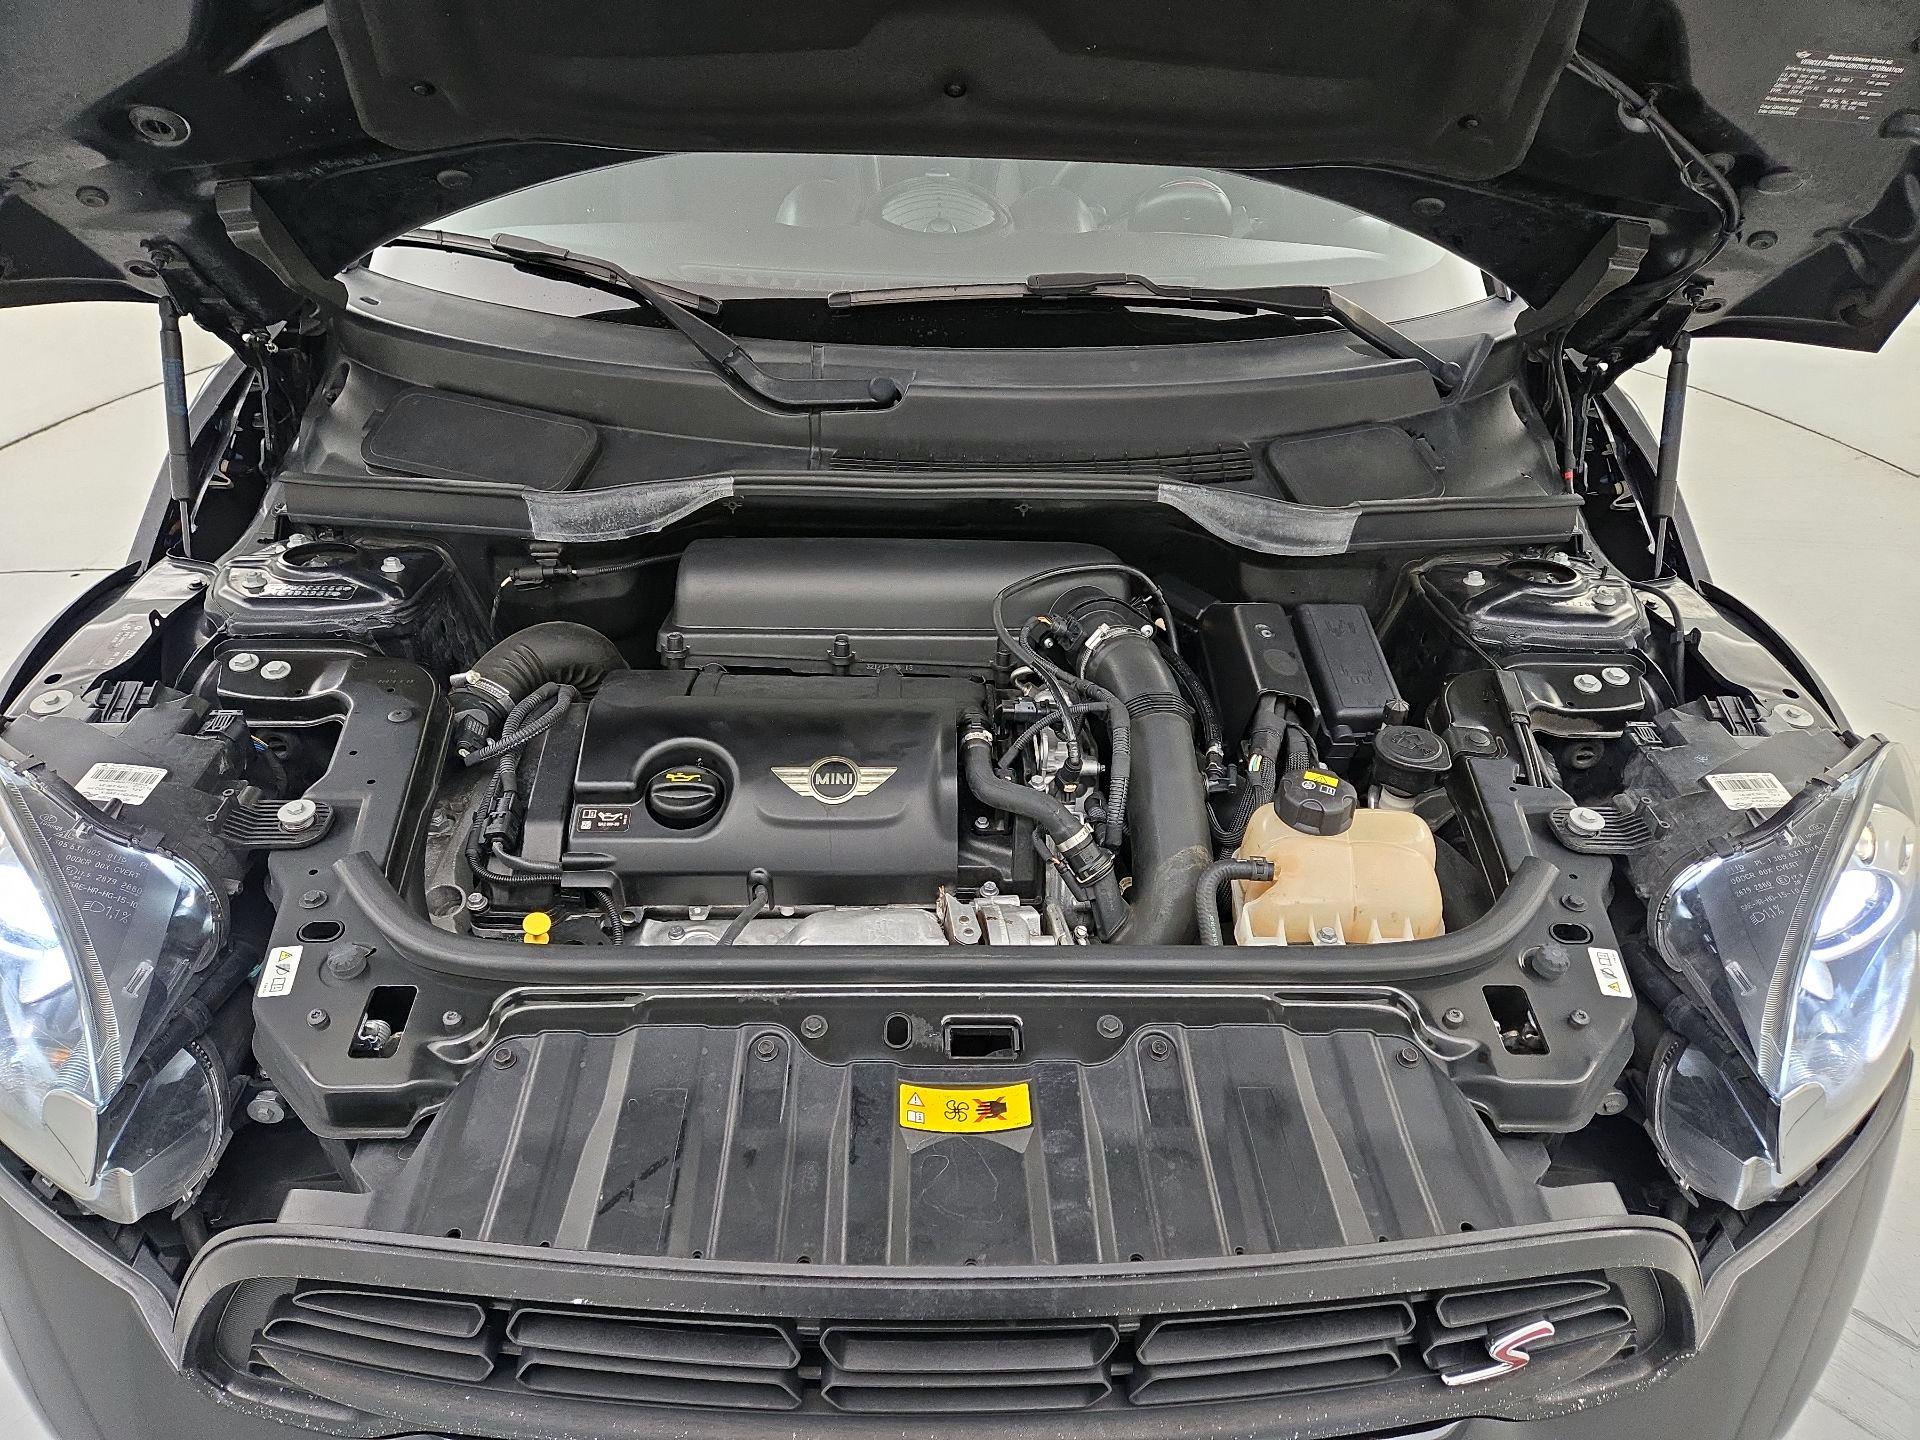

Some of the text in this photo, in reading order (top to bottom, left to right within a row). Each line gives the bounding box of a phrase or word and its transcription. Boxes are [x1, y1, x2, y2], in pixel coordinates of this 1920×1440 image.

[1800, 58, 1823, 66] VEHICLE
[1869, 65, 1905, 74] INFORMATION
[815, 772, 853, 785] MINI
[1441, 1319, 1555, 1386] S
